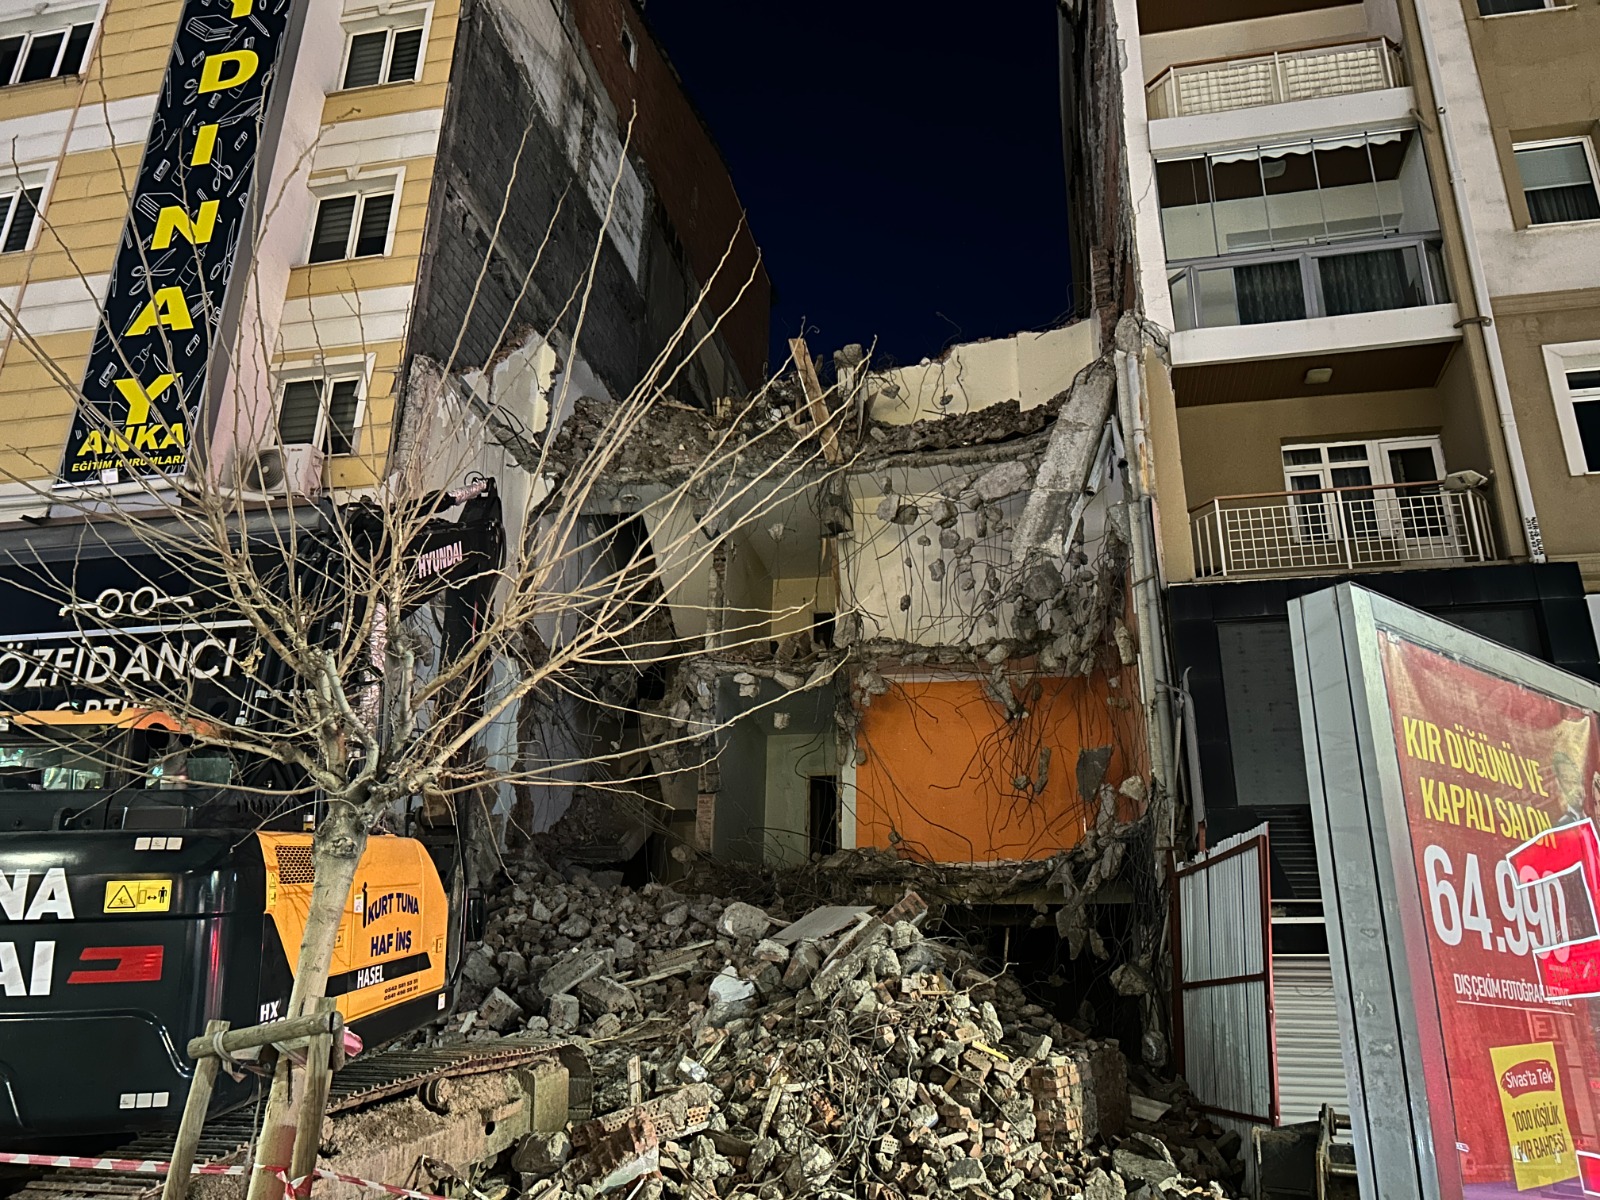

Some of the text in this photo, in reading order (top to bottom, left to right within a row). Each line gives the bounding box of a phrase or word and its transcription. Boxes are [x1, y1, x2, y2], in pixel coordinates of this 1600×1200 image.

[113, 0, 259, 426] DINAY
[76, 423, 185, 456] ANKA
[71, 455, 184, 472] EĞİTİM KURUMLARI
[418, 540, 463, 579] HYUNDAI
[0, 637, 236, 692] ÖZFİDANCI
[1402, 716, 1549, 798] KIR DÜĞÜNÜ VE
[1419, 777, 1558, 849] KAPALI SALON
[368, 892, 419, 925] KURT TUNA
[370, 927, 412, 958] HAF İNŞ
[357, 965, 384, 989] HASEL
[1453, 973, 1472, 1000] DIŞ
[1472, 973, 1501, 1001] ÇEKİM
[260, 1000, 280, 1022] HX
[1505, 1067, 1554, 1088] Sivas'ta Tek
[1512, 1101, 1561, 1132] 1000 KİŞİLİK
[1516, 1139, 1536, 1161] KIR
